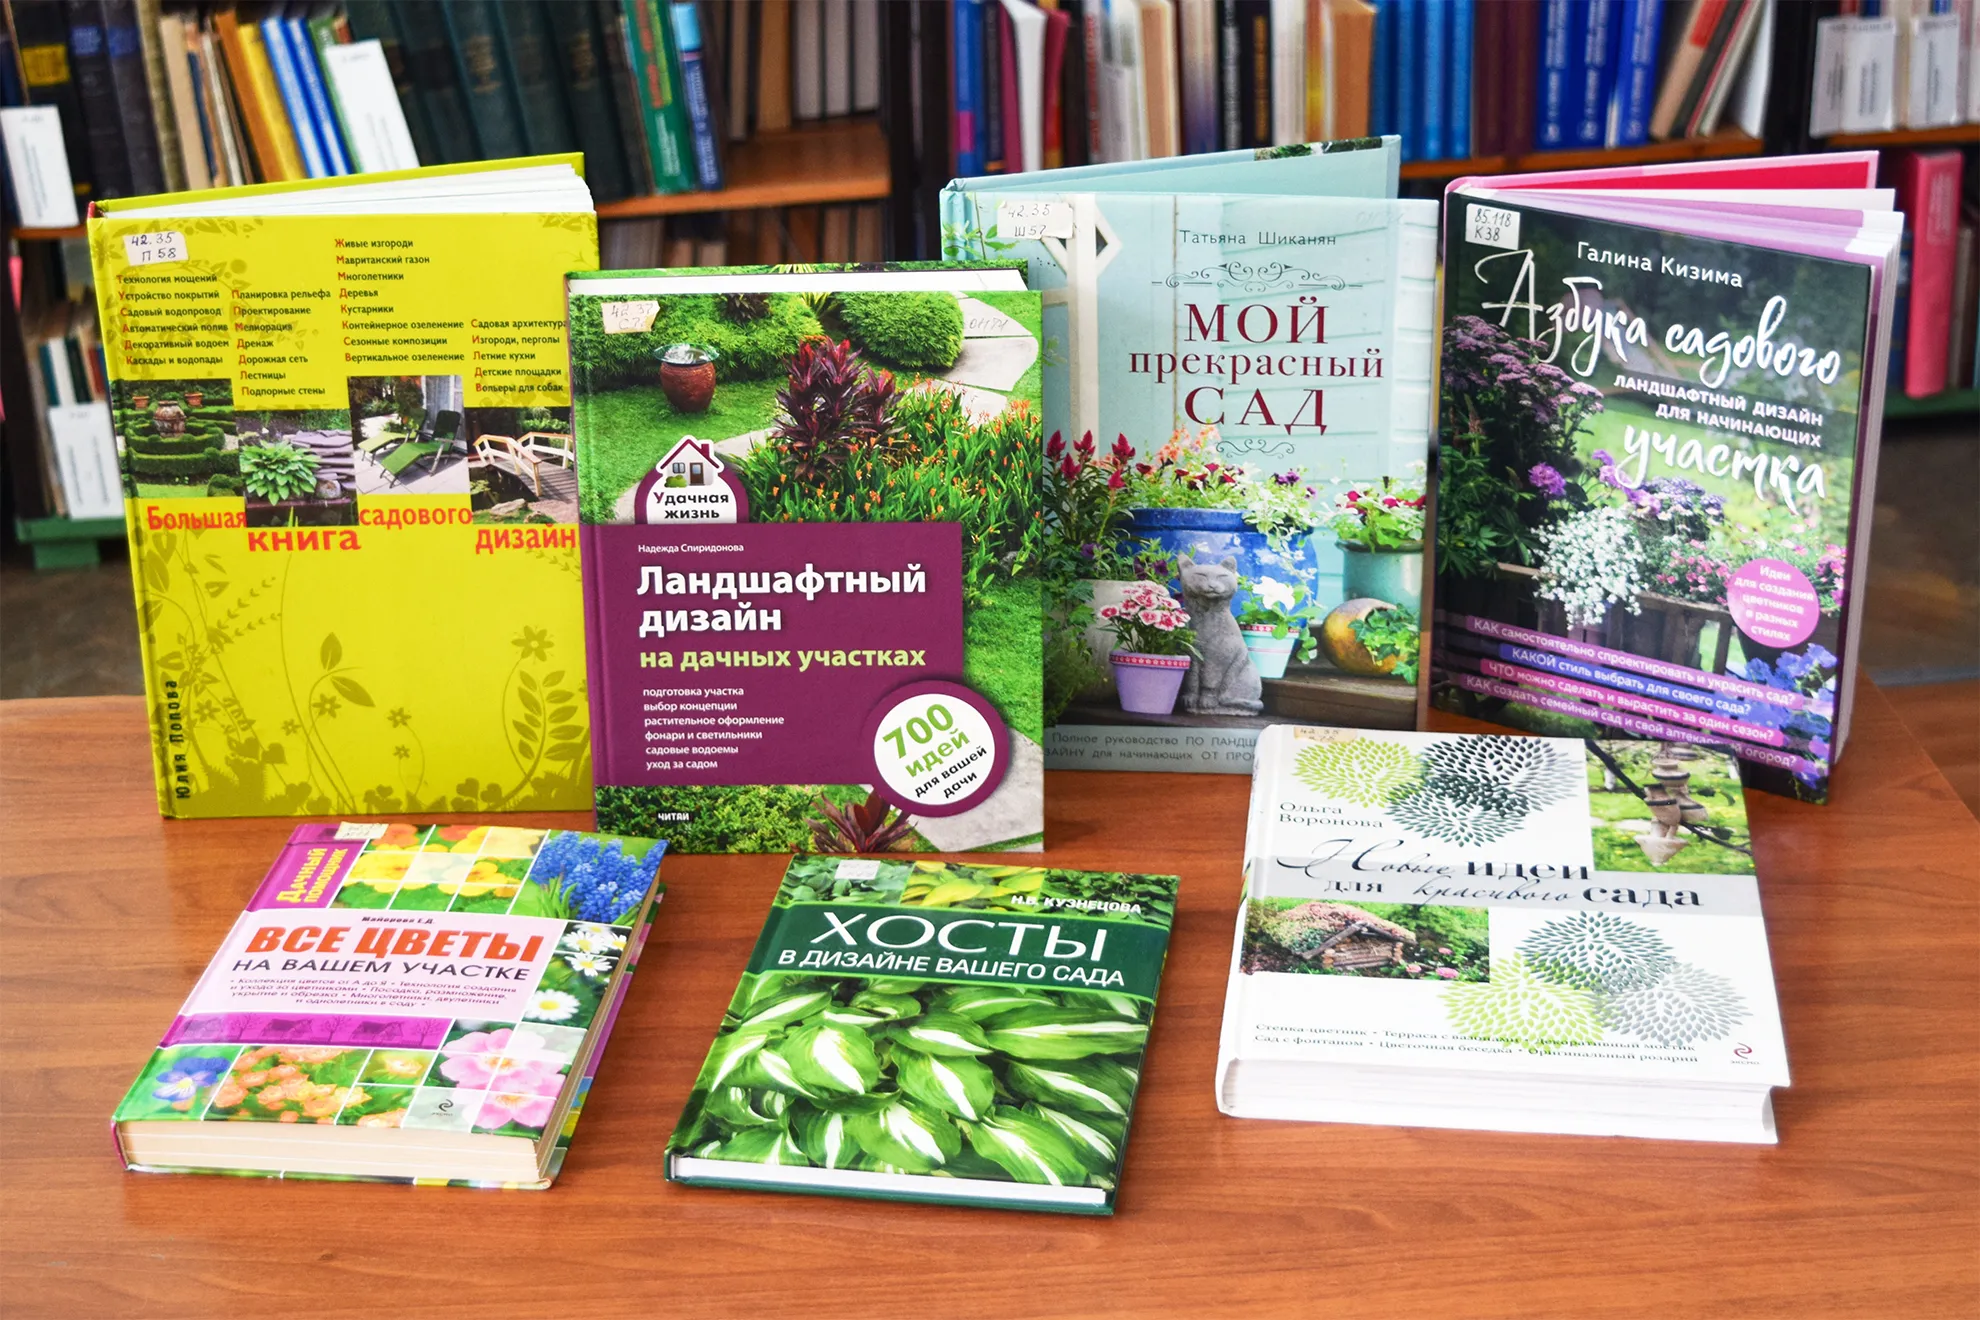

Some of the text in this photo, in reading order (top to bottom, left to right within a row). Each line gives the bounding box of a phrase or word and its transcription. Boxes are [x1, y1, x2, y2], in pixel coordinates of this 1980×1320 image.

[335, 239, 413, 249] Живые изгороди
[1180, 230, 1336, 246] Татьяна Шиканян
[336, 255, 429, 265] Мавританский газон
[1578, 241, 1743, 288] Галина Кизима
[117, 274, 217, 284] Технология мощений
[338, 272, 404, 281] Многолетники
[119, 290, 219, 301] Устройство покрытий
[232, 290, 331, 299] Планировка рельефа
[339, 288, 378, 299] Деревья
[121, 307, 222, 317] Садовый водопровод
[234, 306, 311, 316] Проектирование
[341, 304, 394, 315] Кустарники
[342, 320, 464, 330] Контейнерное озеленение
[471, 319, 509, 328] Садовая
[1184, 296, 1329, 344] МОЙ
[1475, 249, 1840, 389] Азбука садового
[123, 323, 228, 333] Автоматический полив
[235, 323, 292, 332] Мелиорация
[125, 339, 193, 350] Декоративный
[237, 339, 273, 349] Дренаж
[344, 336, 447, 346] Сезонные композиции
[472, 335, 560, 346] Изгороди, перголы
[126, 356, 222, 365] Каскады водопады
[239, 355, 286, 365] Дорожная
[345, 353, 465, 362] Вертикальное озеленение
[473, 352, 535, 362] Летние кухни
[1129, 348, 1384, 384] прекрасный
[241, 371, 286, 380] Лестницы
[475, 368, 561, 378] Детские площадки
[242, 387, 325, 396] Подпорные стены
[476, 383, 563, 393] Вольеры для собак
[1613, 374, 1824, 427] ЛАНДШАФТНЫЙ ДИЗАЙН
[1184, 386, 1327, 436] САД
[1656, 403, 1821, 447] ДЛЯ НАЧИНАЮЩИХ
[1615, 424, 1825, 500] участка
[653, 491, 729, 506] Удачная
[147, 506, 473, 530] Большая садового
[665, 508, 720, 519] жизнь
[248, 523, 576, 554] книга дизайн
[638, 543, 744, 553] Надежда Спиридонова
[1760, 565, 1791, 581] Идеи
[637, 563, 926, 600] Ландшафтный
[1743, 594, 1804, 614] цветников
[639, 601, 781, 638] дизайн
[640, 649, 926, 671] на дачных участках
[1474, 619, 1796, 704] КАК самостоятельно спроектировать украсить сад?
[1512, 648, 1750, 714] КАКОЙ стиль выбрать для своего сада?
[643, 688, 744, 698] подготовка участка
[644, 701, 737, 712] выбор концепции
[1489, 662, 1774, 740] ЧТО можно сделать вырастить за один сезон?
[645, 716, 784, 727] растительное оформление
[1467, 678, 1796, 766] КАК создать семейный сад свой огород?
[645, 731, 762, 741] фонари светильники
[883, 704, 953, 759] 700
[166, 681, 190, 799] Юлия Попова
[1053, 733, 1098, 743] Полное
[1105, 736, 1178, 746] руководство
[1186, 737, 1204, 746] ПО
[646, 746, 738, 755] садовые водоемы
[905, 728, 970, 777] идей
[1092, 750, 1219, 760] для начинающих ОТ
[646, 761, 670, 770] уход
[686, 761, 717, 769] садом
[915, 746, 987, 798] для вашей
[943, 772, 977, 798] дачи
[1280, 801, 1343, 815] Ольга
[1279, 813, 1384, 828] Воронова
[1276, 839, 1589, 880] Новые идеи
[276, 848, 328, 904] Дачный
[1324, 877, 1704, 907] для красивого сада
[1044, 897, 1141, 913] КУЗНЕЦОВА
[810, 912, 1107, 961] ХОСТЫ
[245, 926, 545, 962] ВСЕ ЦВЕТЫ
[232, 959, 531, 981] НА ВАШЕМ УЧАСТКЕ
[779, 950, 1125, 986] В ДИЗАЙНЕ ВАШЕГО САДА
